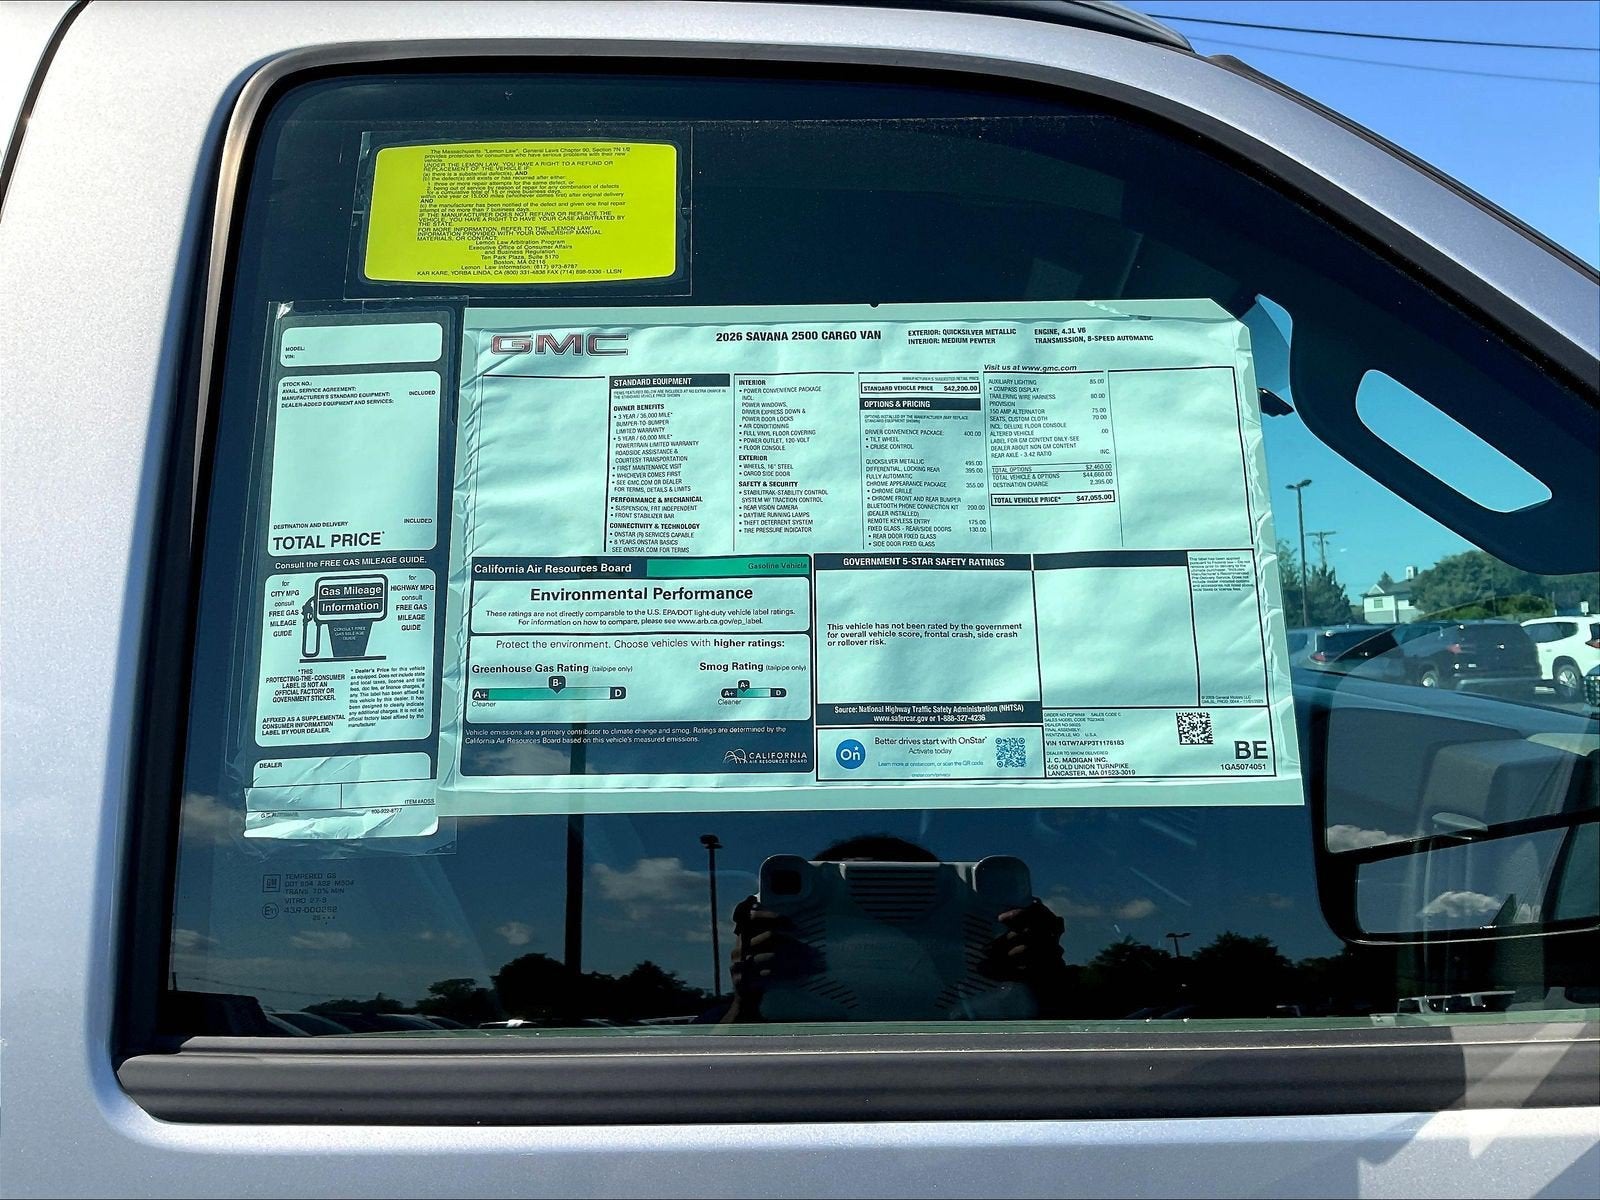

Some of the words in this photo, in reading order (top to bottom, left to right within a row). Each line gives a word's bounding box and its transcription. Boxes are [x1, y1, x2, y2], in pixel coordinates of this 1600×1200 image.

[908, 329, 940, 337] EXTERIOR:
[942, 328, 983, 336] QUICKSILVER
[984, 328, 1016, 336] METALLIC
[1034, 328, 1060, 336] ENGINE,
[1061, 327, 1075, 336] 4.3L
[1077, 327, 1086, 335] V6
[715, 331, 742, 343] 2026
[745, 331, 788, 342] SAVANA
[791, 331, 818, 342] 2500
[821, 330, 856, 341] CARGO
[859, 330, 881, 341] VAN
[908, 337, 939, 345] INTERIOR:
[941, 337, 968, 345] MEDIUM
[1034, 336, 1085, 344] TRANSMISSION,
[1087, 335, 1115, 343] 8-SPEED
[1116, 335, 1154, 343] AUTOMATIC
[490, 333, 629, 356] GMC
[984, 364, 1000, 372] Visit
[1001, 364, 1011, 372] us
[1011, 364, 1020, 372] at
[1021, 364, 1077, 372] www.gmc.com
[613, 378, 651, 387] STANDARD
[652, 377, 692, 386] EQUIPMENT
[613, 404, 635, 412] OWNER
[636, 403, 665, 411] BENEFITS
[864, 400, 894, 409] OPTIONS
[895, 400, 901, 409] &
[901, 400, 930, 409] PRICING
[1013, 496, 1038, 504] VEHICLE
[1076, 494, 1112, 502] $47,055.00
[275, 561, 304, 570] Consult
[305, 560, 318, 569] the
[319, 560, 340, 568] FREE
[342, 559, 360, 567] GAS
[361, 557, 397, 567] MILEAGE
[398, 556, 427, 565] GUIDE.
[748, 562, 779, 570] Gasoline
[779, 561, 807, 570] Vehicle
[843, 558, 899, 566] GOVERNMENT
[902, 558, 933, 566] 5-STAR
[935, 558, 966, 566] SAFETY
[968, 558, 1005, 567] RATINGS
[474, 563, 524, 575] California
[526, 563, 542, 574] Air
[544, 562, 597, 574] Resources
[600, 562, 632, 574] Board
[321, 586, 340, 596] Gas
[341, 585, 382, 595] Mileage
[390, 584, 418, 592] HIGHWAY
[530, 588, 647, 601] Environmental
[652, 587, 753, 601] Performance
[322, 601, 379, 612] Information
[413, 603, 428, 611] GAS
[827, 623, 843, 631] This
[845, 623, 873, 631] vehicle
[874, 623, 889, 631] has
[890, 623, 904, 631] not
[905, 623, 925, 631] been
[926, 623, 948, 631] rated
[949, 623, 960, 631] by
[960, 623, 974, 631] the
[975, 622, 1022, 631] government
[827, 631, 838, 639] for
[840, 631, 866, 639] overall
[868, 631, 896, 639] vehicle
[897, 631, 922, 639] score,
[924, 631, 950, 639] frontal
[951, 631, 975, 639] crash,
[976, 631, 993, 639] side
[995, 631, 1018, 639] crash
[496, 639, 529, 649] Protect
[532, 639, 547, 649] the
[549, 639, 610, 649] environment.
[613, 639, 648, 649] Choose
[650, 639, 688, 649] vehicles
[690, 639, 711, 649] with
[713, 638, 745, 649] higher
[747, 638, 785, 649] ratings:
[827, 638, 835, 646] or
[837, 638, 868, 646] rollover
[868, 638, 886, 646] risk.
[471, 663, 532, 674] Greenhouse
[534, 663, 554, 674] Gas
[556, 662, 589, 674] Rating
[699, 661, 728, 672] Smog
[731, 661, 764, 672] Rating
[474, 691, 488, 699] A+
[614, 689, 622, 697] D
[471, 700, 496, 708] Cleaner
[717, 698, 742, 706] Cleaner
[834, 706, 857, 715] Source:
[858, 705, 884, 715] National
[884, 705, 910, 715] Highway
[912, 705, 931, 714] Traffic
[932, 705, 951, 714] Safety
[952, 704, 998, 714] Administration
[998, 704, 1024, 714] (NHTSA)
[874, 737, 897, 745] Better
[898, 737, 921, 745] drives
[921, 737, 939, 745] start
[940, 737, 957, 745] with
[1234, 740, 1268, 760] BE
[749, 752, 808, 760] CALIFORNIA
